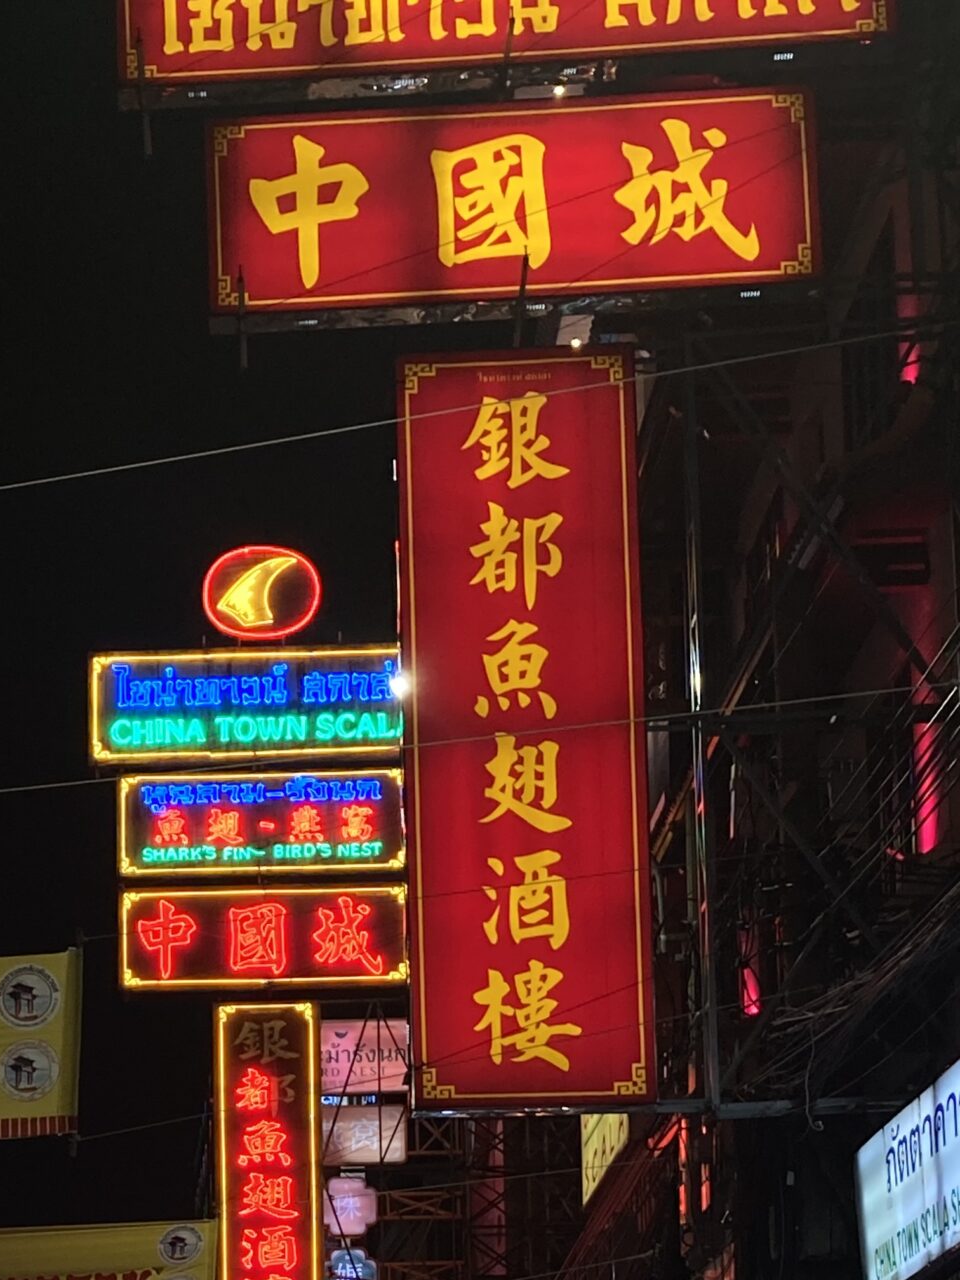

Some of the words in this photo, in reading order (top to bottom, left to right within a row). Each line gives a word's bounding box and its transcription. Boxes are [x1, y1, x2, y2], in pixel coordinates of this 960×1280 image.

[249, 119, 760, 290] 中國城
[111, 663, 287, 707] ไชน่าทาวน์
[303, 660, 398, 702] สกาล่
[110, 716, 207, 745] CHINA
[214, 713, 308, 743] TOWN
[315, 711, 403, 740] SCAL
[460, 391, 582, 1073] 銀都魚翅酒樓
[142, 846, 217, 862] SHARK'S
[223, 847, 253, 860] FIN
[273, 843, 332, 857] BIRD'S
[338, 841, 382, 857] NEST
[137, 897, 382, 979] 中國城
[886, 1092, 960, 1193] ภัตตาคา
[874, 1236, 897, 1280] CHINA
[897, 1216, 920, 1262] TOWN
[920, 1196, 950, 1250] SCALA
